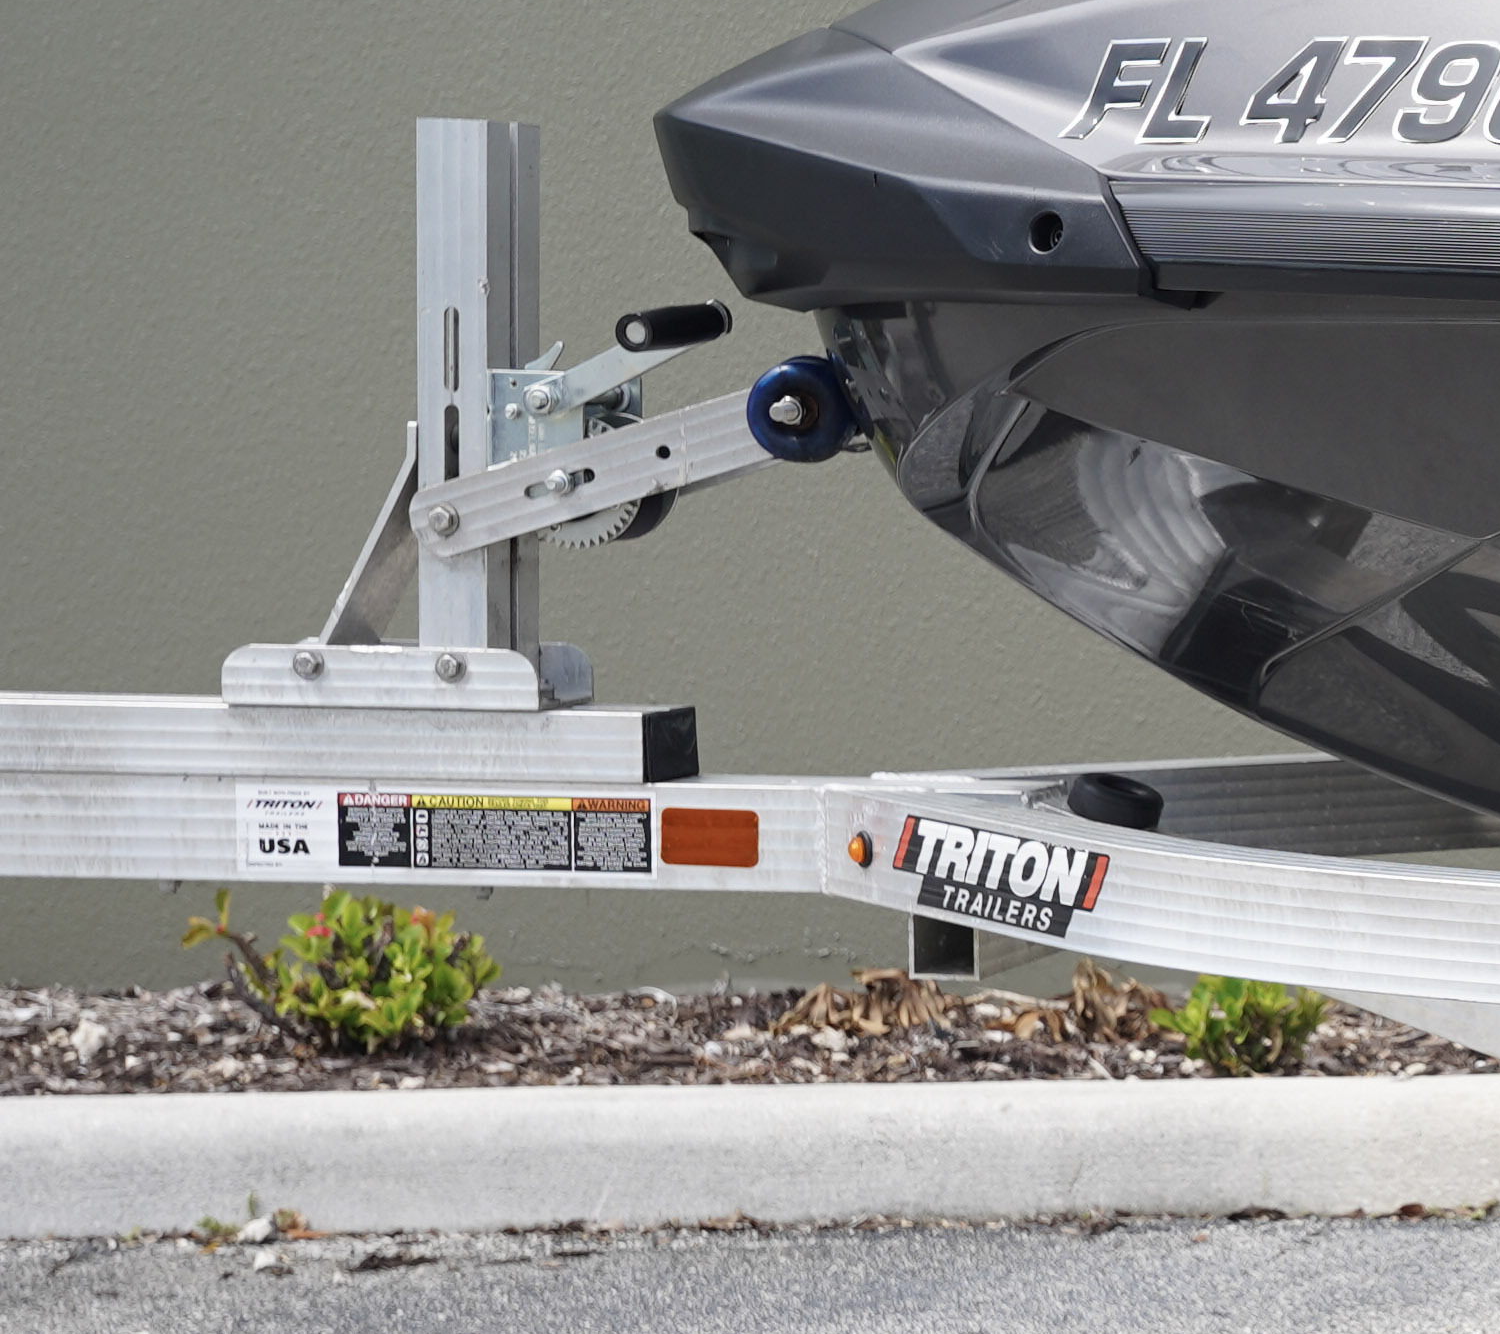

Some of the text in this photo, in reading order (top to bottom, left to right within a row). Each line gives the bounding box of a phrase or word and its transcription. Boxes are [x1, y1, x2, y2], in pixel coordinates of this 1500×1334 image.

[1057, 35, 1211, 145] FL
[255, 798, 316, 810] TRITON
[354, 793, 408, 806] DANGER
[429, 795, 484, 808] CAUTION
[588, 798, 646, 811] WARNING
[258, 838, 310, 855] USA
[915, 818, 1089, 907] TRITON
[942, 884, 1054, 932] TRAILERS
